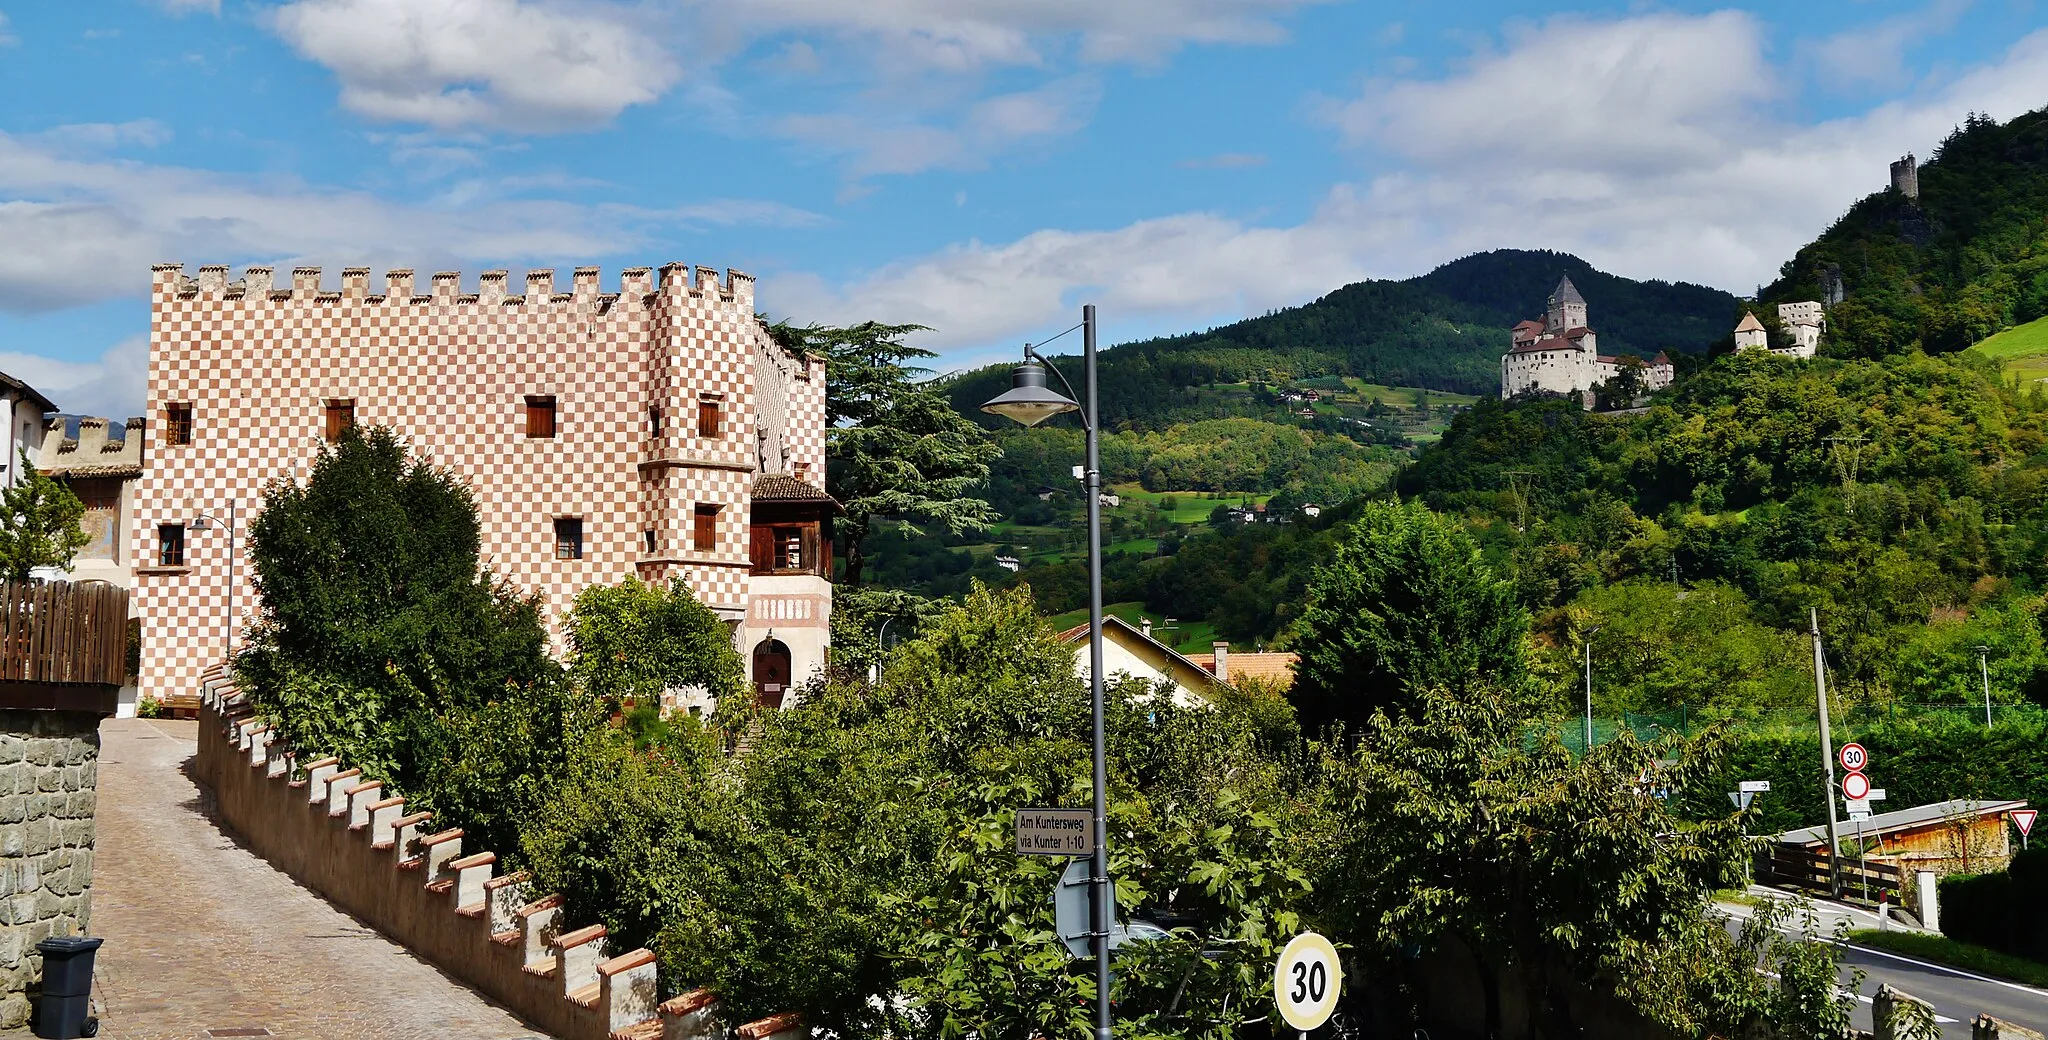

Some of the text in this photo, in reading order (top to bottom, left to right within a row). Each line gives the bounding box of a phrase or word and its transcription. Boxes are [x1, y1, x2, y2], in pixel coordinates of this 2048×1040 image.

[1846, 750, 1861, 764] 30
[1020, 815, 1084, 832] Am Kuntersweg
[1020, 834, 1032, 848] via
[1034, 835, 1062, 849] Kunter
[1291, 960, 1327, 1004] 30
